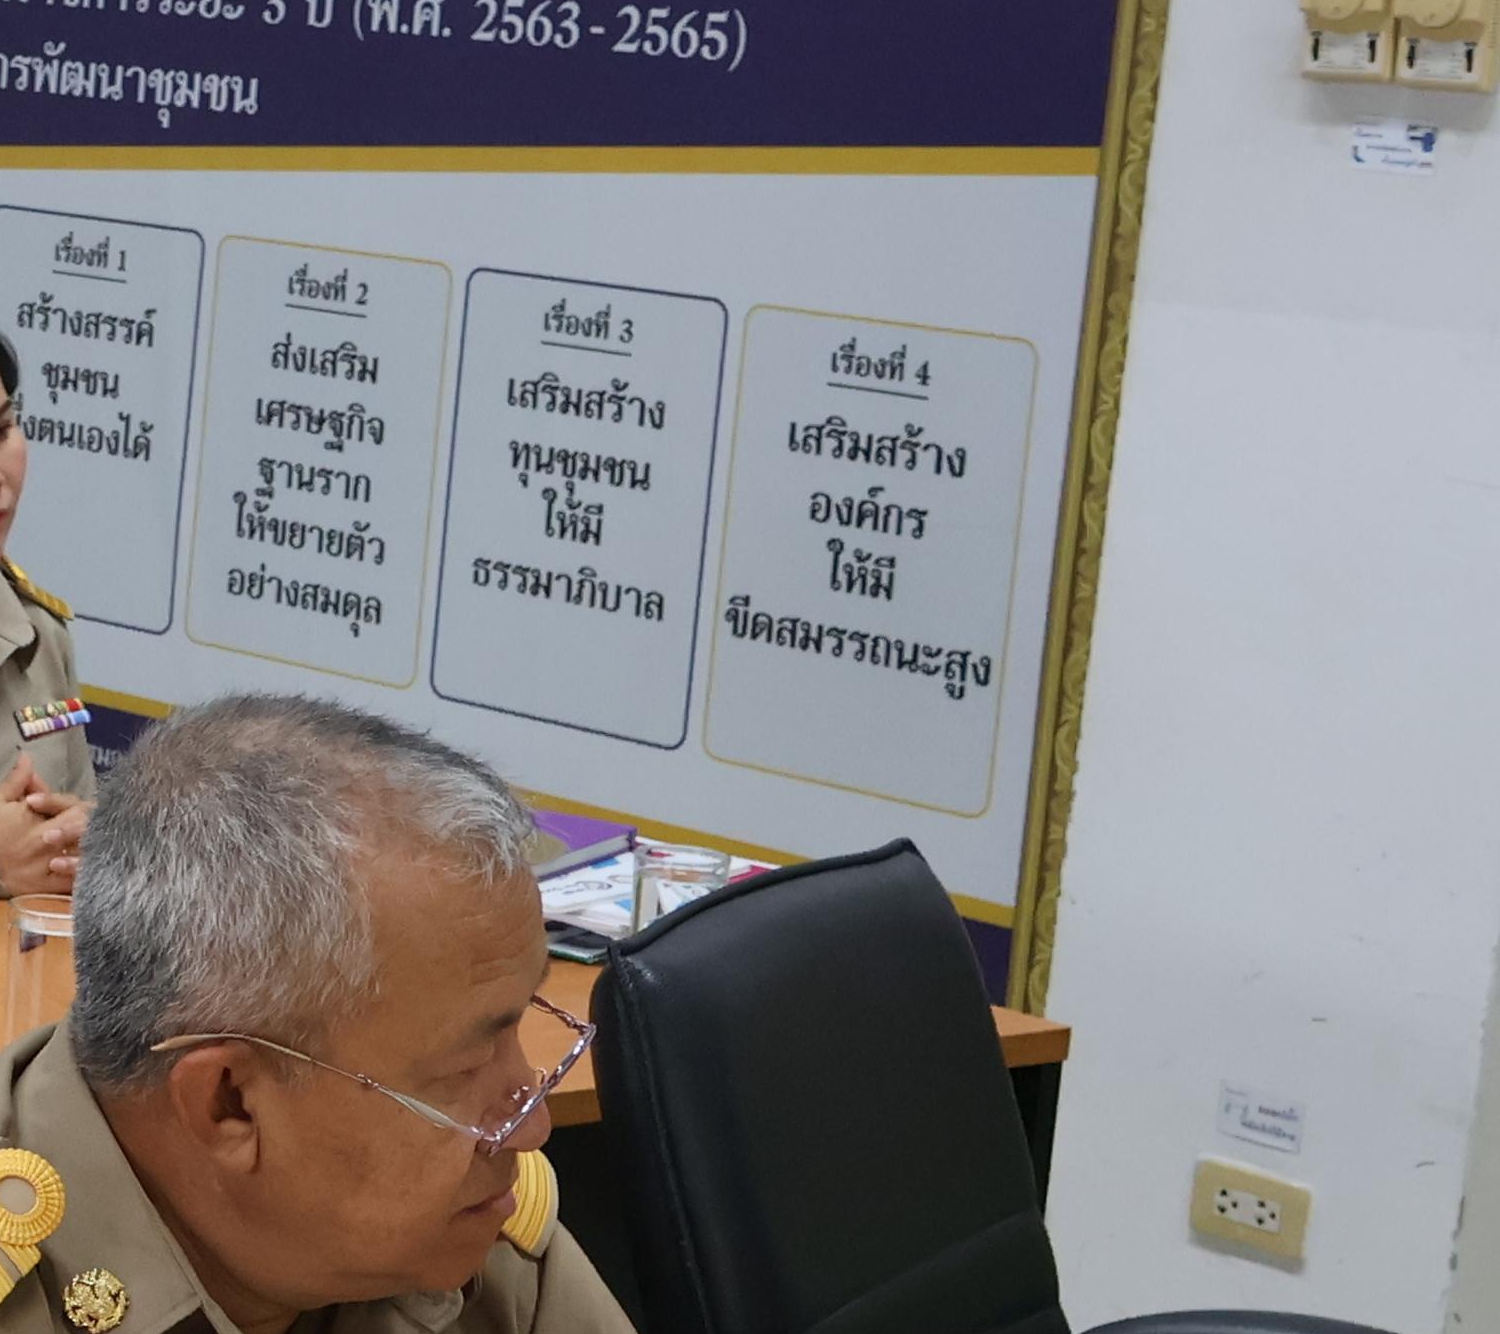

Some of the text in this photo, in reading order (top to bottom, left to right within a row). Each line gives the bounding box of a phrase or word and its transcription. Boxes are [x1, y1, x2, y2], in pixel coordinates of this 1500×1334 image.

[53, 227, 129, 273] เรื่องที่ 1
[286, 261, 370, 307] เรื่องที่ 2
[16, 291, 156, 350] สร้างสรรค์
[543, 298, 636, 345] เรื่องที่ 3
[41, 355, 120, 405] ชุมชน
[269, 335, 380, 385] ส่งเสริม
[830, 336, 933, 389] เรื่องที่ 4
[254, 392, 386, 453] เศรษฐกิจ
[505, 369, 667, 430] เสริมสร้าง
[509, 434, 652, 496] ทุนชุมชน
[787, 415, 968, 478] เสริมสร้าง
[256, 453, 373, 505] ฐานราก
[231, 494, 387, 566] ให้ขยายตัว
[542, 488, 604, 548] ให้มี
[809, 485, 929, 541] องค์กร
[471, 554, 667, 624] ธรรมาภิบาล
[826, 538, 896, 603] ให้มี
[226, 564, 384, 638] อย่างสมดุล
[724, 594, 993, 703] ขีดสมรรถนะสูง
